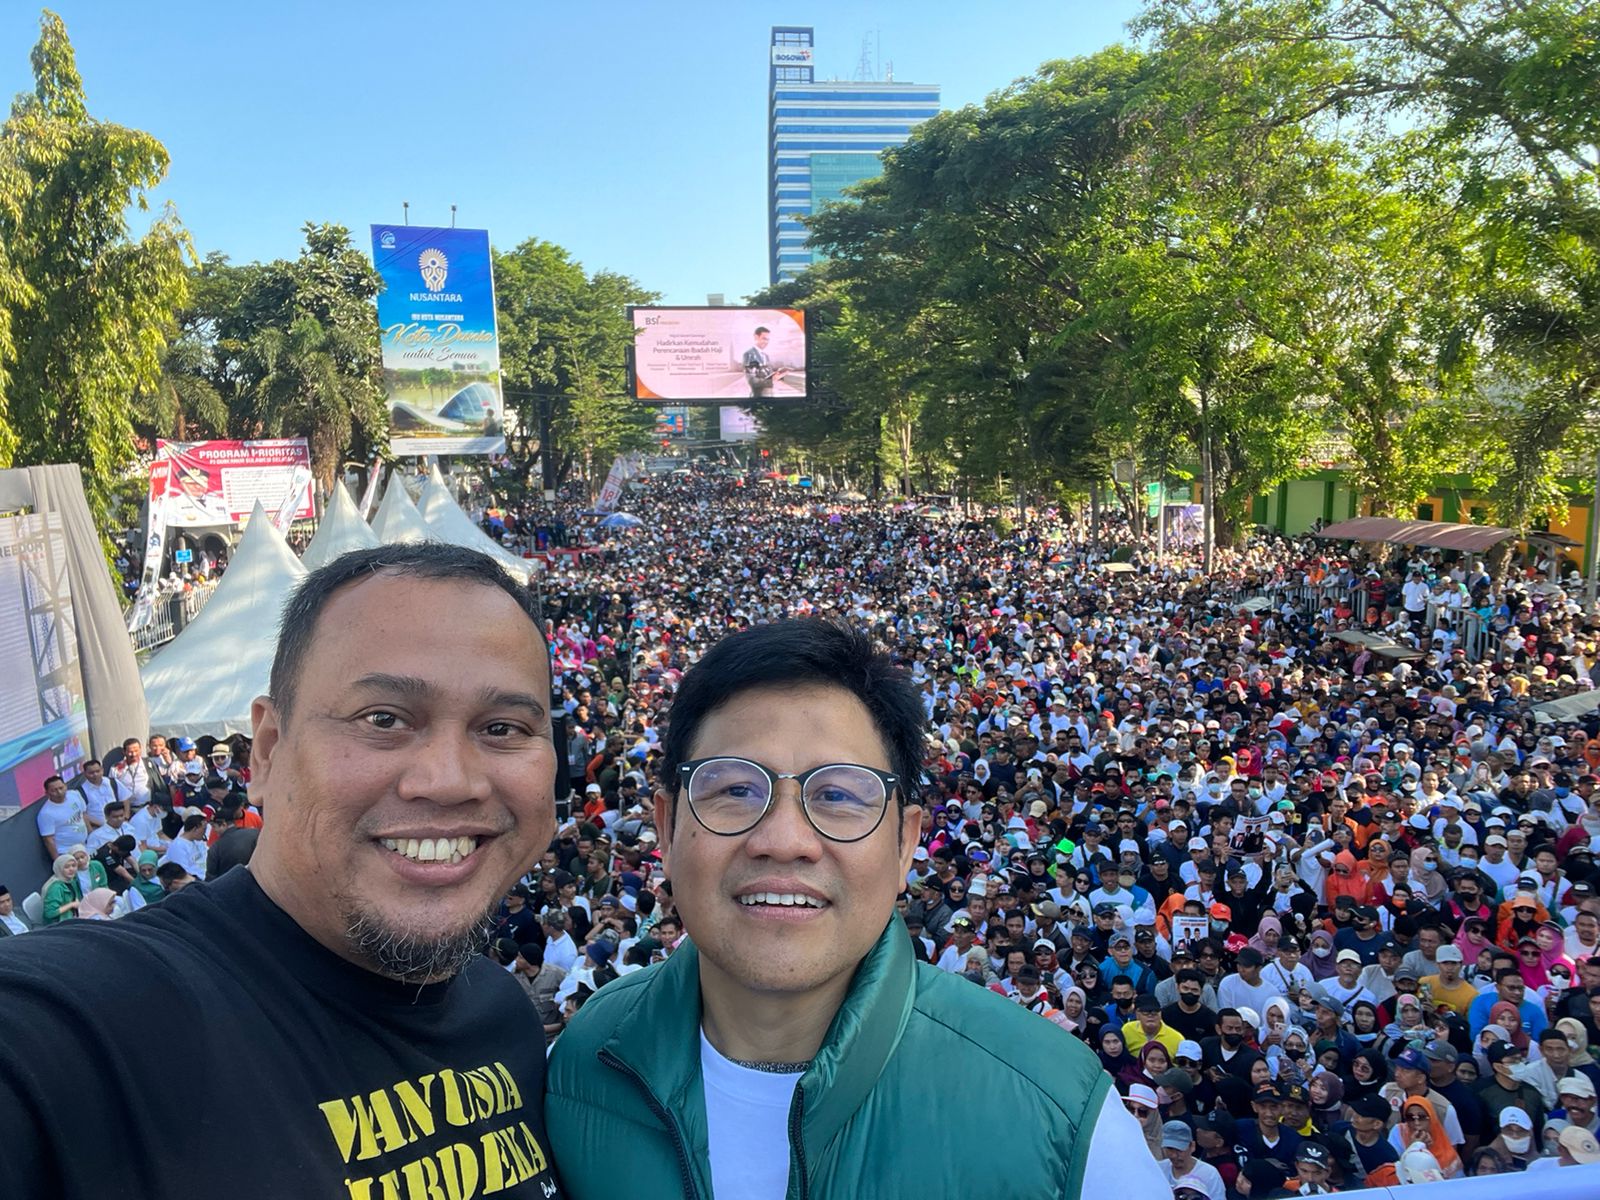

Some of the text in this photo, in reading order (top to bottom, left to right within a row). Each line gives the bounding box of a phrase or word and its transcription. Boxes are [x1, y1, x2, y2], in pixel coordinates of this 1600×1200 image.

[409, 293, 463, 303] NUSANTARA
[645, 317, 660, 325] BSI
[384, 322, 495, 346] Kota Dunia
[403, 346, 478, 361] untuk Semua
[199, 447, 303, 459] PROGRAM PRIORITAS
